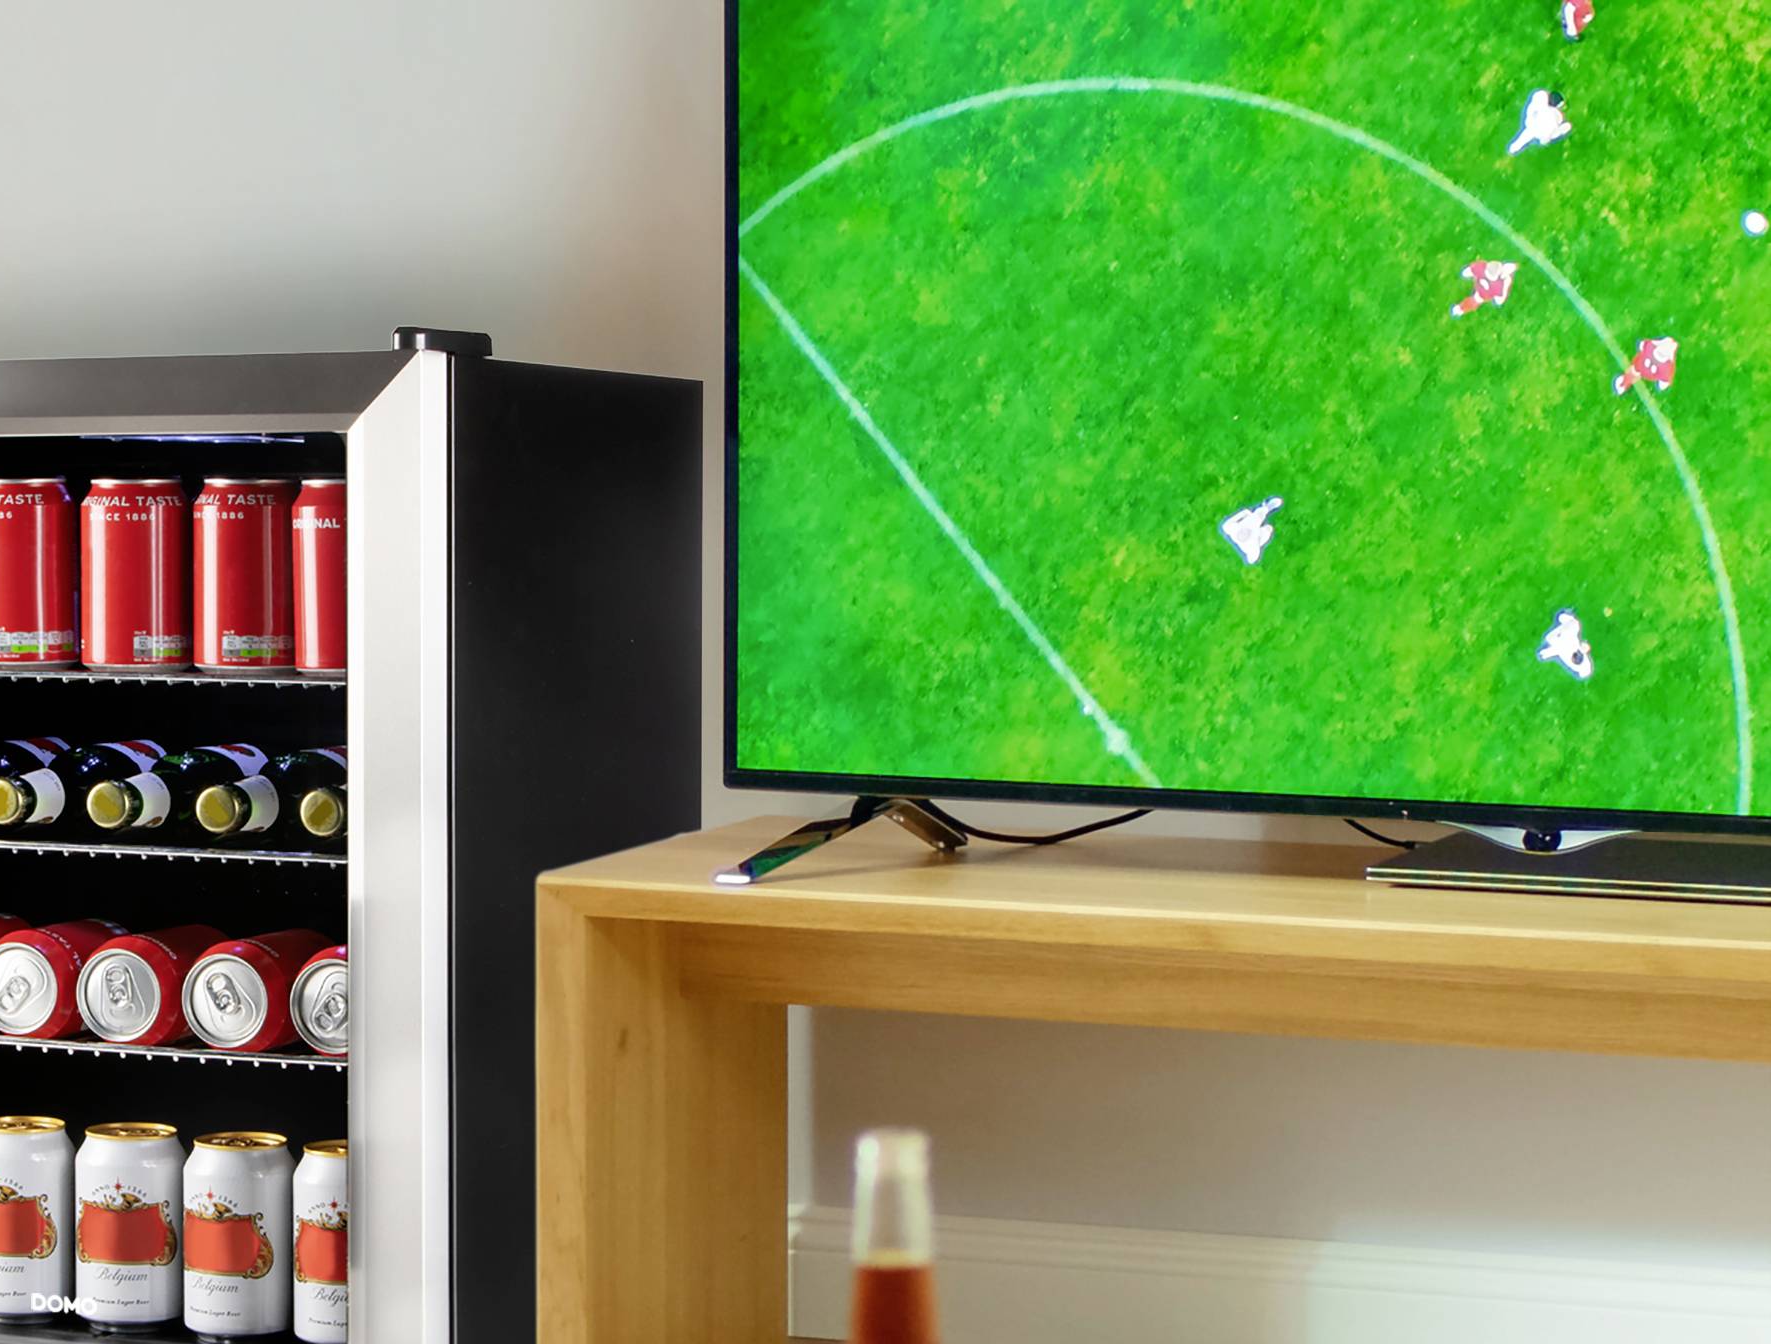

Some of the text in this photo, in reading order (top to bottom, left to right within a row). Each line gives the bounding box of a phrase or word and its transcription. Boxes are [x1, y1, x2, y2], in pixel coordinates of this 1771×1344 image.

[136, 496, 182, 507] TASTE
[228, 494, 277, 505] TASTE
[95, 1266, 149, 1287] Belgium
[191, 1275, 239, 1297] Belgium
[30, 1292, 98, 1316] DOMO
